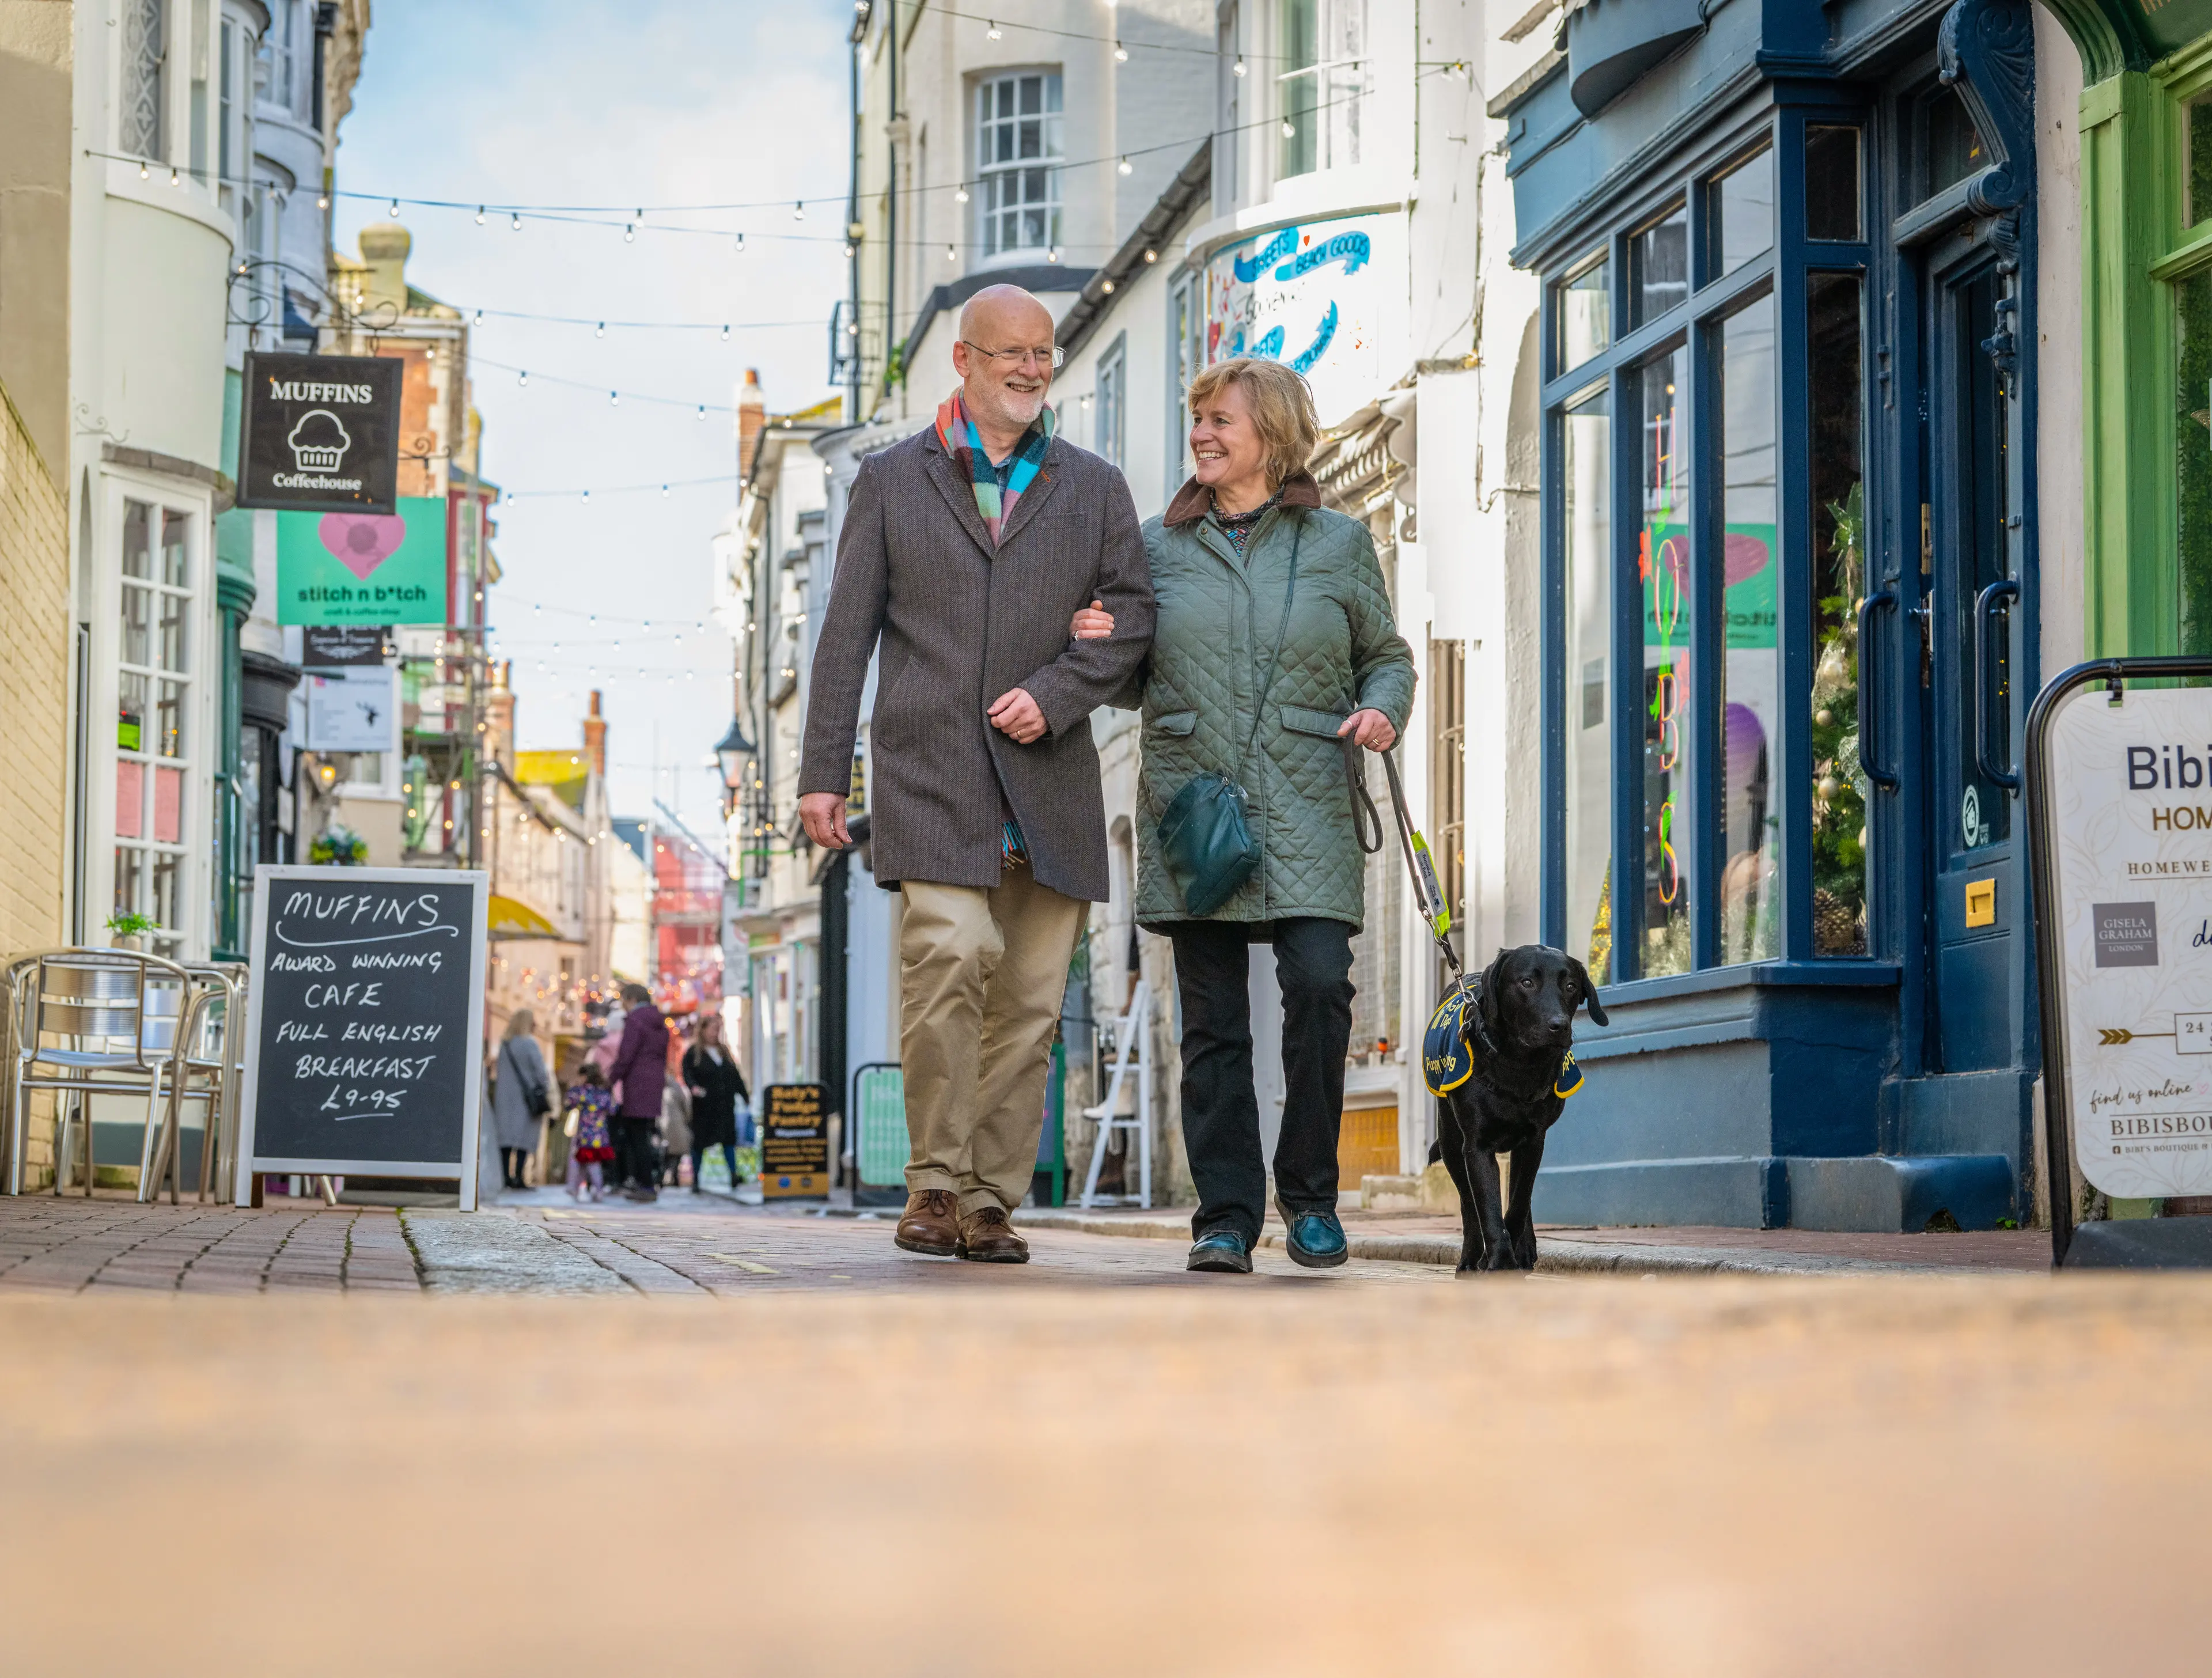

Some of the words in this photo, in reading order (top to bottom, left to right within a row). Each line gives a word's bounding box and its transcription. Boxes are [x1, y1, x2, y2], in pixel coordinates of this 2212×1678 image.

[1296, 243, 1327, 274] BEACH
[1331, 234, 1368, 257] GOODS
[270, 381, 373, 404] MUFFINS
[272, 472, 362, 491] Coffeehouse
[297, 585, 352, 602] stitch
[358, 588, 370, 601] n
[1422, 854, 1431, 876] training
[283, 891, 439, 926] MUFFINS
[2099, 928, 2153, 941] GRAHAM
[2104, 918, 2147, 930] GISELA
[2108, 944, 2144, 953] LONDON
[270, 952, 336, 972] AWARD
[351, 951, 442, 974] WINNING
[305, 982, 384, 1009] CAFE
[275, 1020, 329, 1043] FULL
[341, 1022, 442, 1043] ENGLISH
[2186, 1021, 2204, 1033] 24
[294, 1054, 437, 1080] BREAKFAST
[2089, 1086, 2123, 1115] find
[2128, 1090, 2143, 1106] us
[2148, 1078, 2193, 1098] online
[2124, 1144, 2151, 1154] BIBI'S
[2153, 1143, 2199, 1153] BOUTIQUE
